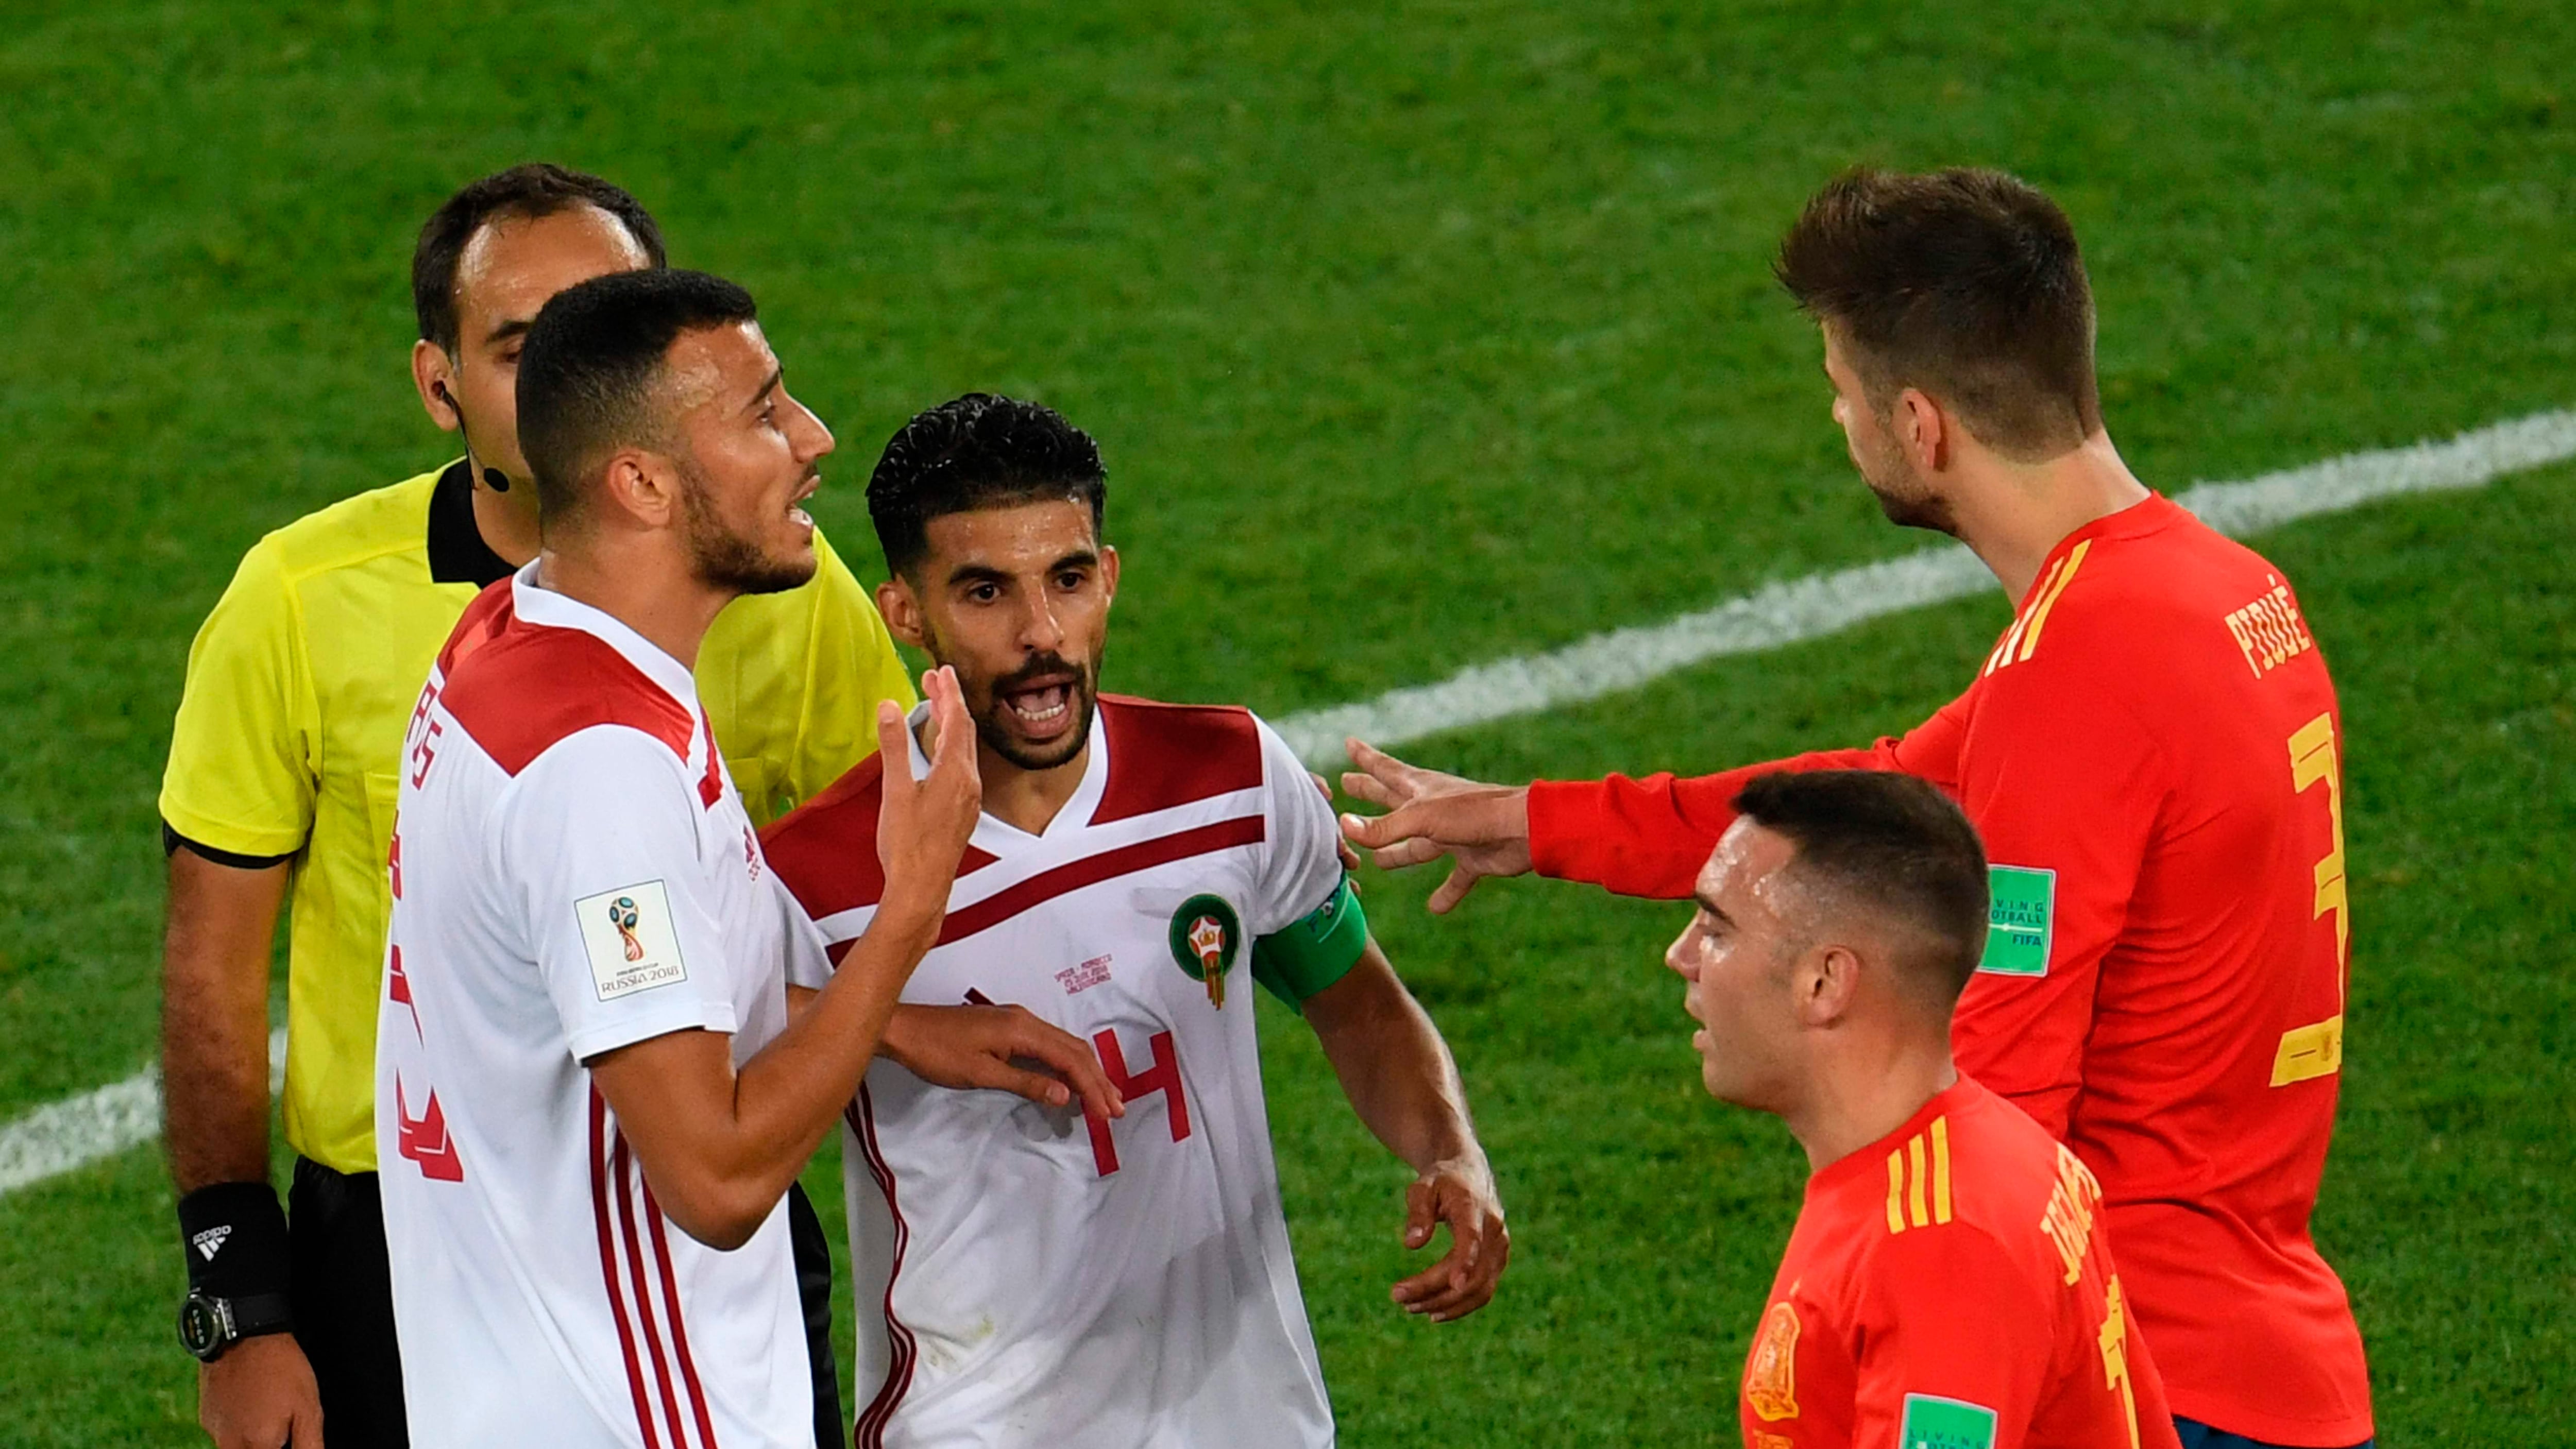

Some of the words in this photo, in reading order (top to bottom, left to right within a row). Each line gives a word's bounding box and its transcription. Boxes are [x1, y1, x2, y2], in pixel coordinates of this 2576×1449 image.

[1996, 899, 2044, 912] VING
[2269, 711, 2348, 1088] 3
[1991, 909, 2042, 924] OTBALL
[2012, 933, 2042, 947] FIFA
[601, 973, 647, 993] RUSSIA
[649, 966, 679, 981] 2018
